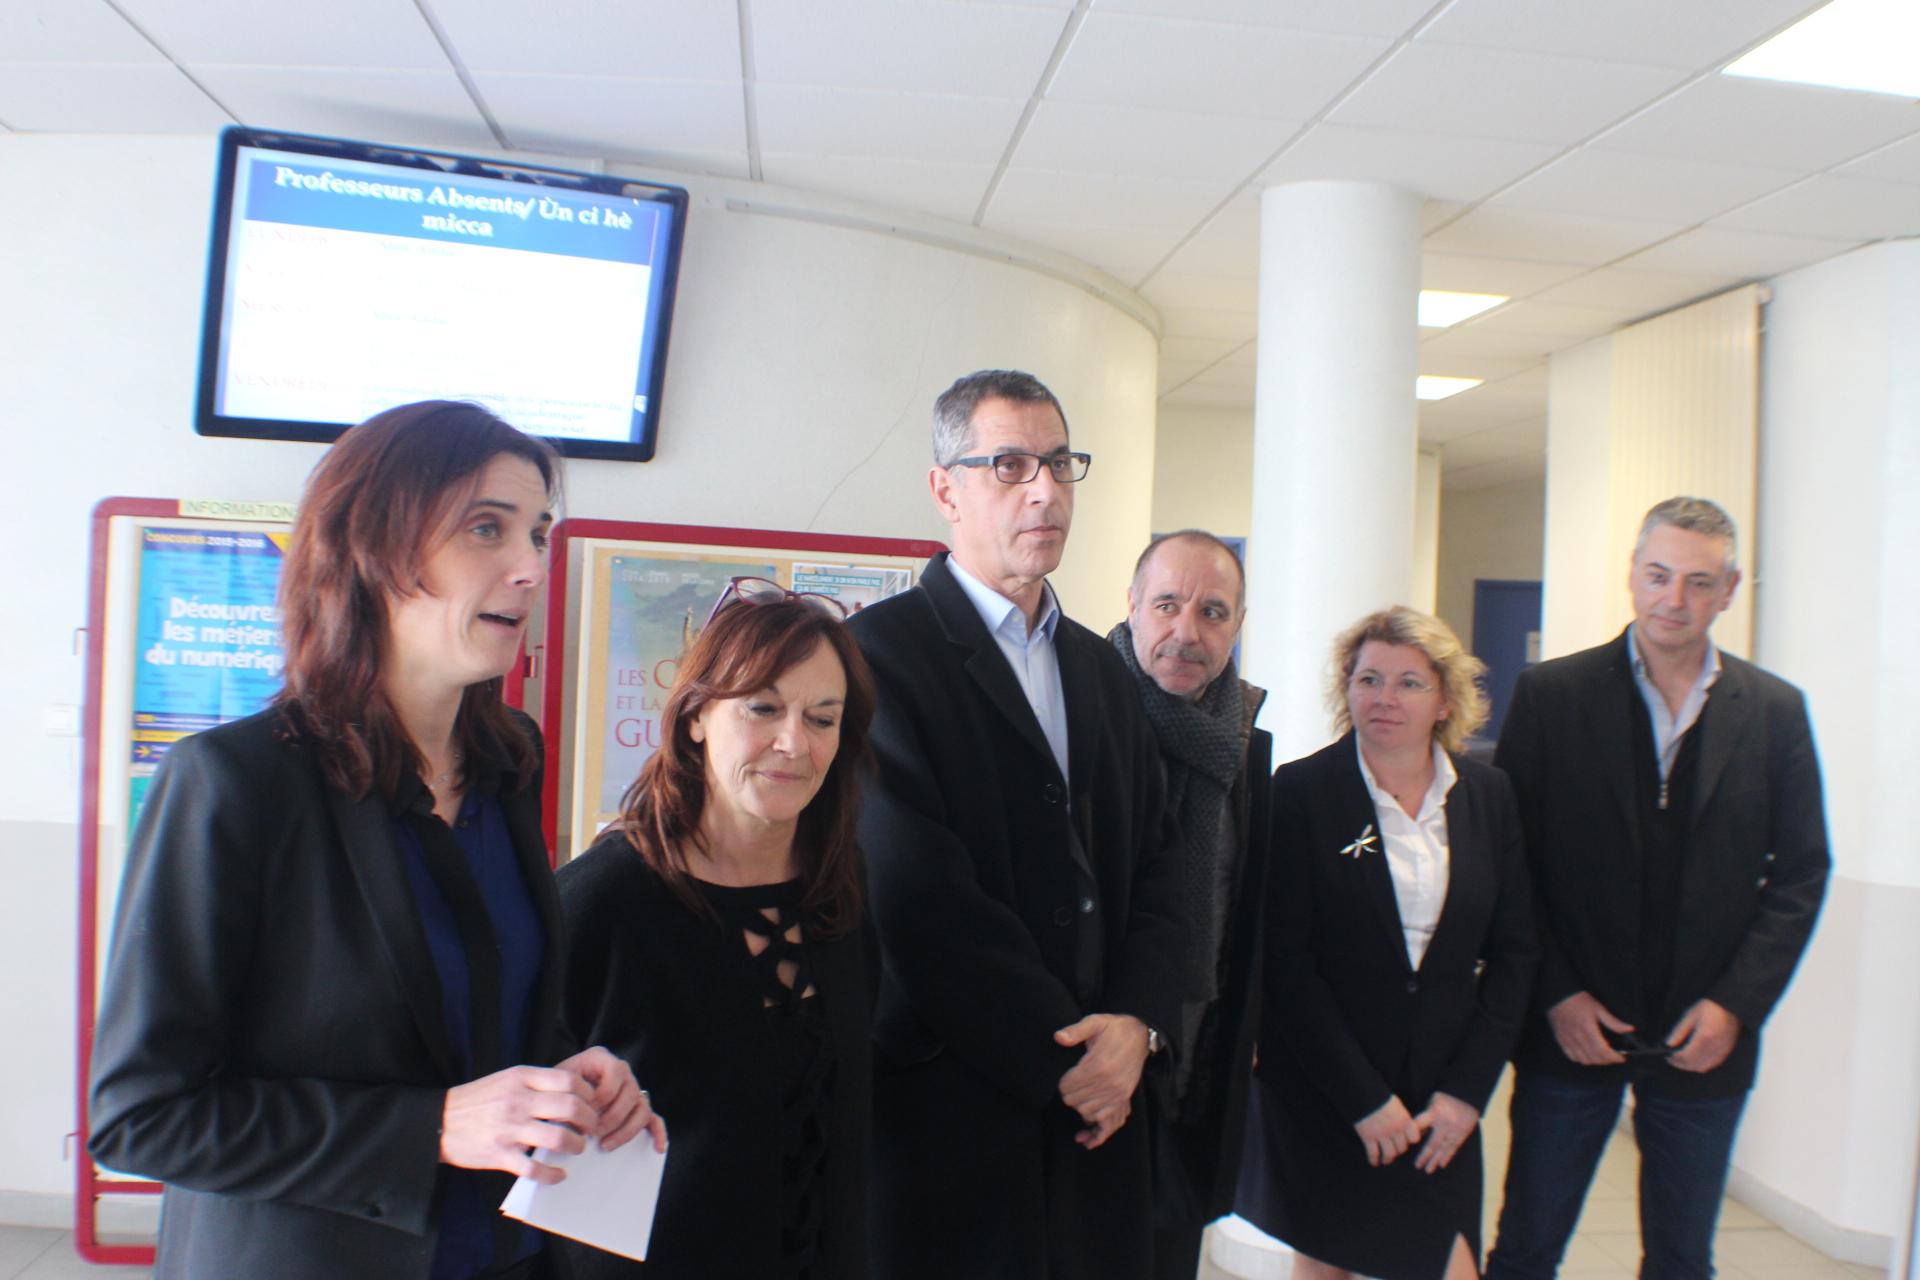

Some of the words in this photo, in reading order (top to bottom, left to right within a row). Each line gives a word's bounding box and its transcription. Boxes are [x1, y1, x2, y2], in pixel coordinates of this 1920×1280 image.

[275, 165, 422, 201] Professeurs
[537, 196, 574, 223] Ùn
[578, 206, 599, 226] ci
[603, 208, 632, 230] hè
[421, 212, 494, 238] micca
[163, 620, 196, 642] les
[145, 642, 176, 665] du
[180, 645, 285, 676] numériqu
[618, 669, 647, 687] LES
[654, 659, 680, 689] C
[617, 695, 635, 710] ET
[641, 696, 662, 711] LA
[615, 718, 661, 748] GU
